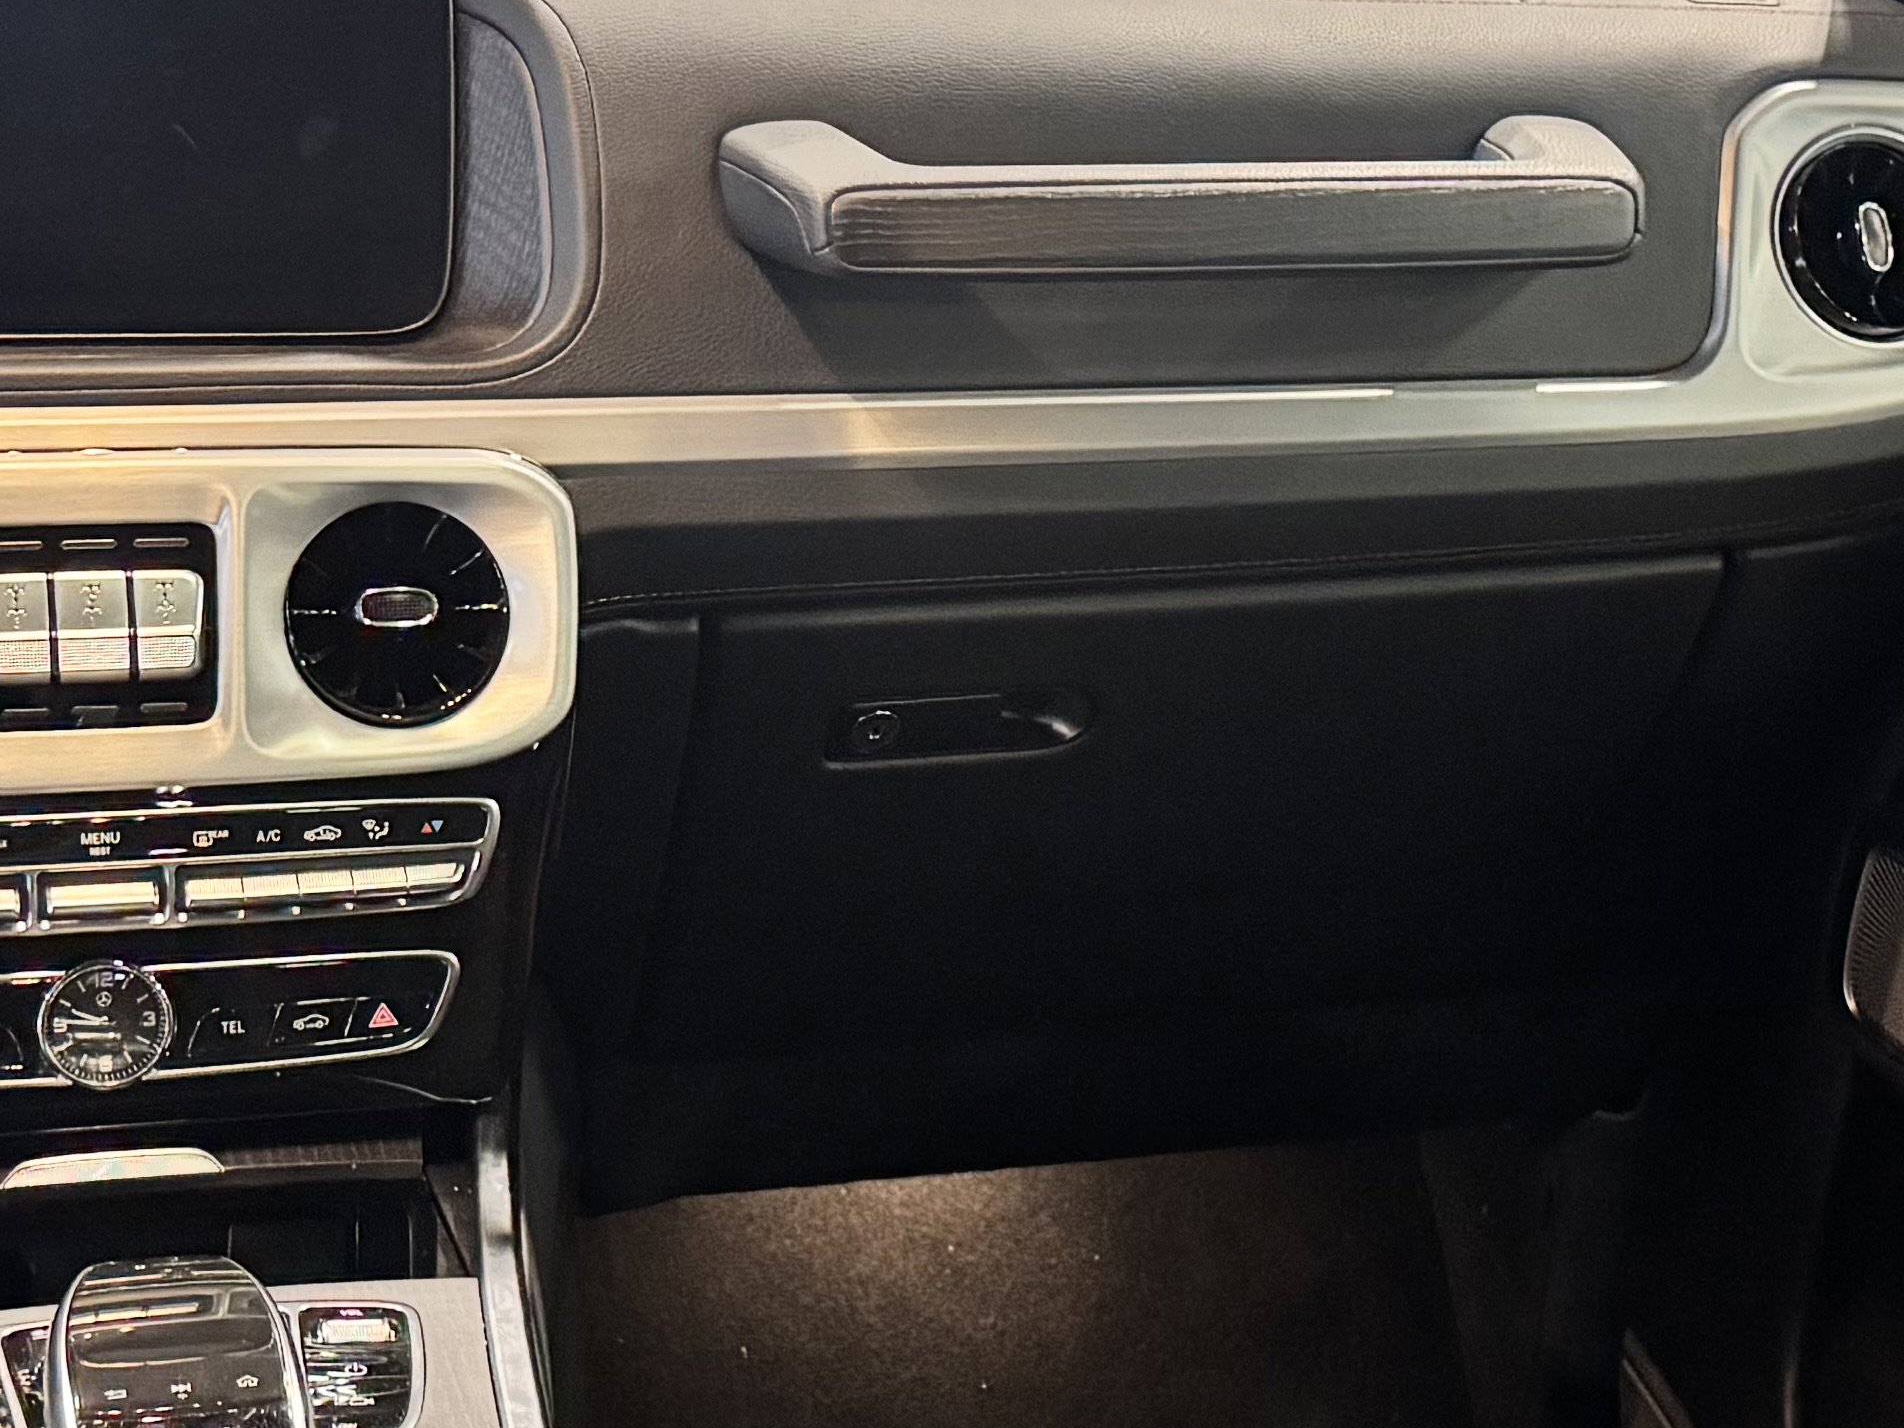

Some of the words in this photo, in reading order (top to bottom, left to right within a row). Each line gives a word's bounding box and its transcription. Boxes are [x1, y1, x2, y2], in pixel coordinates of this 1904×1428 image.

[80, 831, 121, 845] MENU
[256, 829, 281, 843] A/C
[142, 1011, 156, 1027] 3
[221, 1021, 245, 1034] TEL
